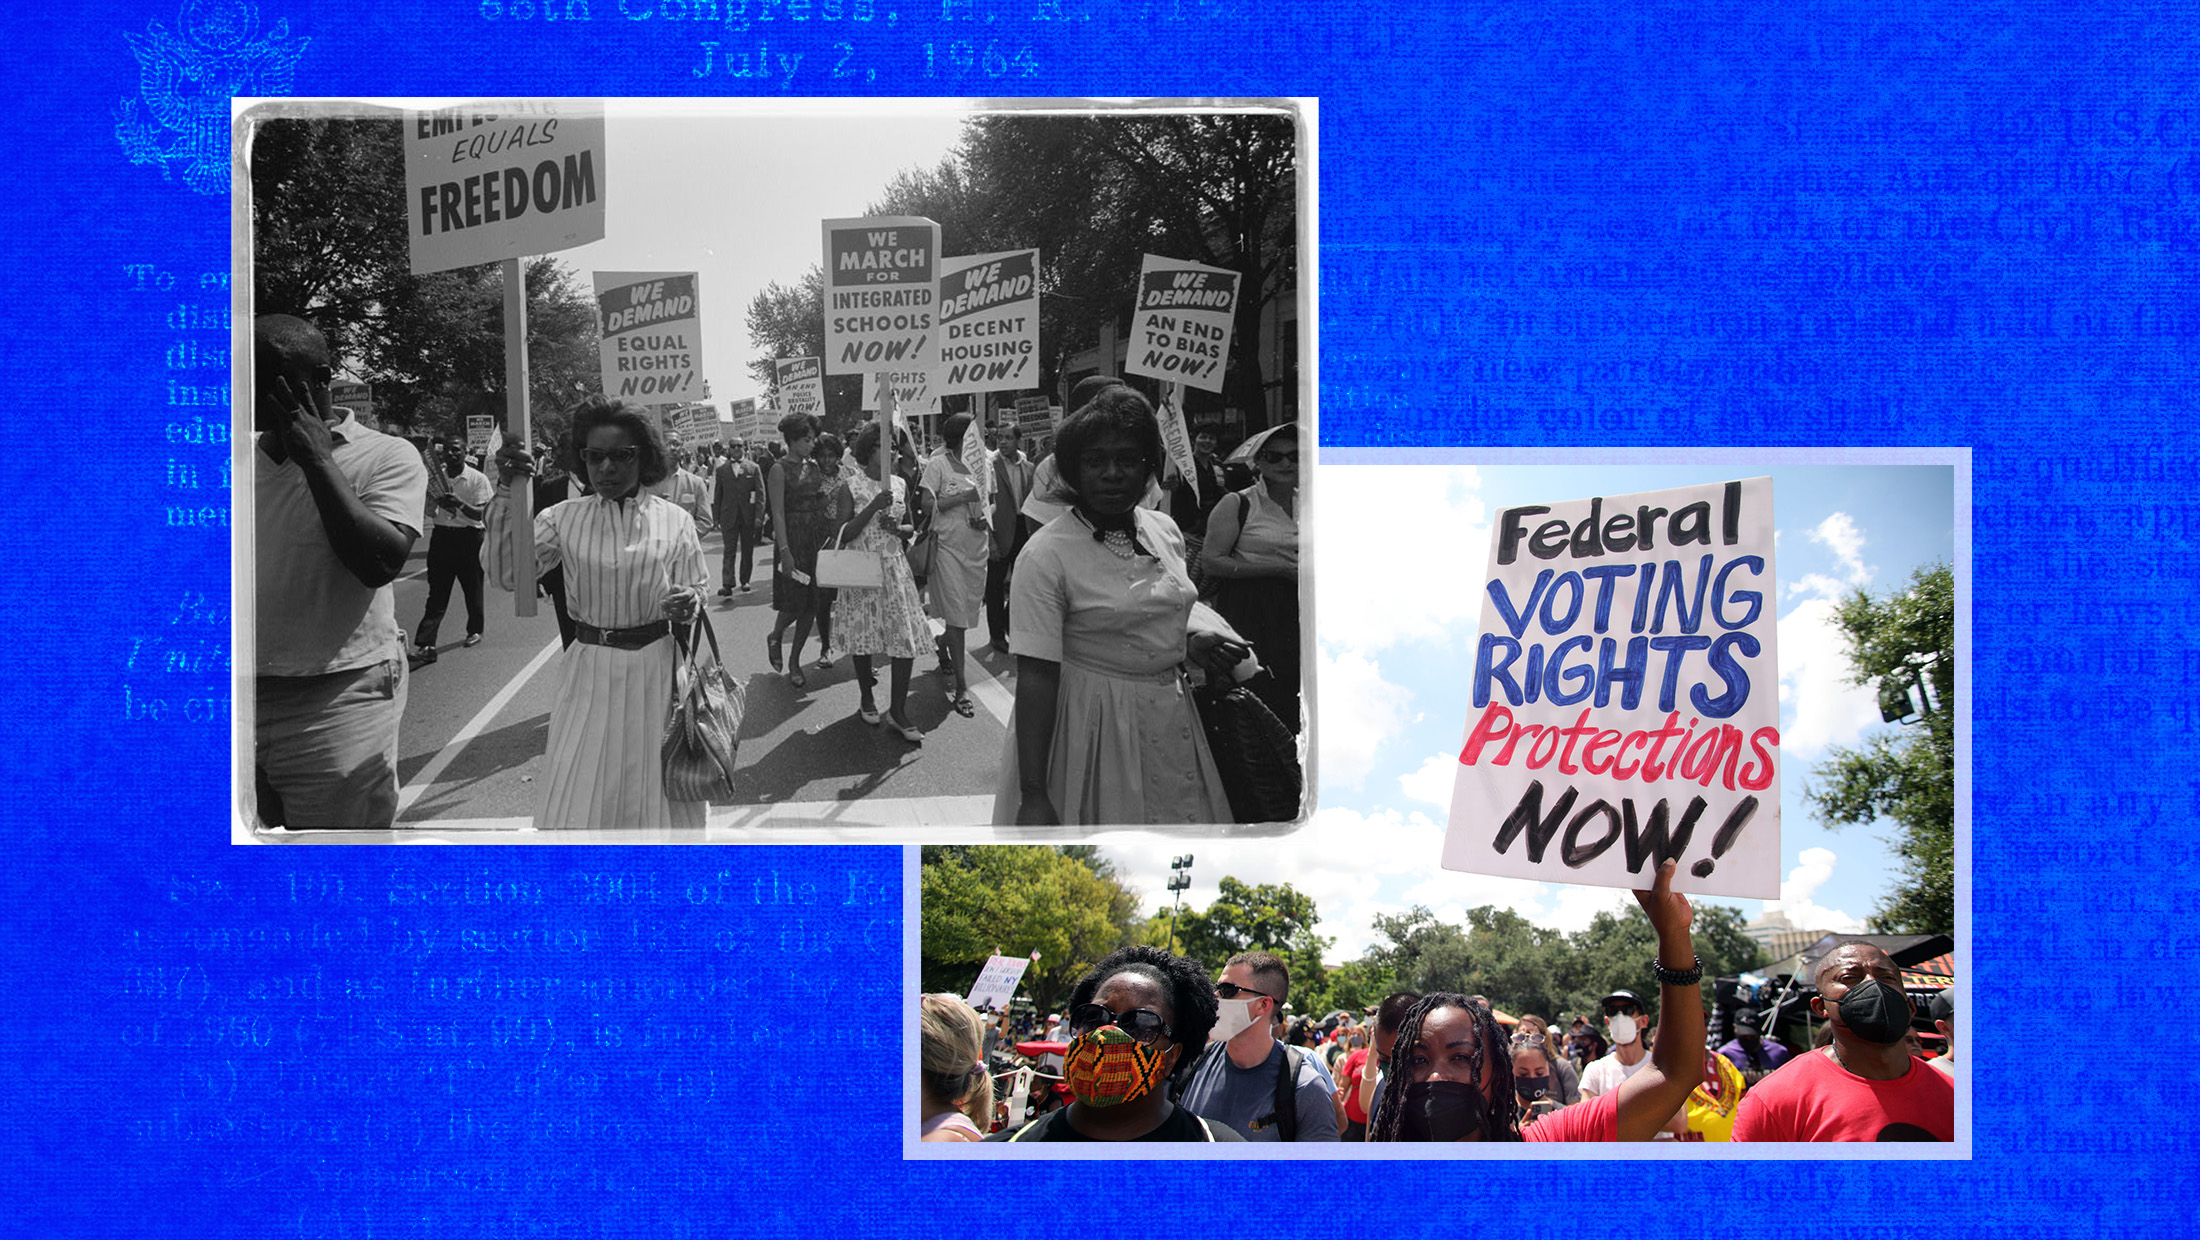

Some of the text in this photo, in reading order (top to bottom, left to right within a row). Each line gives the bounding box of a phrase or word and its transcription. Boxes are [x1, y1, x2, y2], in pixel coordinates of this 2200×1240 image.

[692, 38, 1040, 91] July 2, 1964
[452, 118, 559, 164] EQUALS
[421, 149, 597, 237] FREEDOM
[867, 231, 898, 247] WE
[840, 249, 925, 271] MARCH
[866, 272, 900, 282] FOR
[965, 262, 1002, 290] WE
[1172, 272, 1209, 289] WE
[630, 281, 665, 306] WE
[833, 289, 933, 310] INTEGRATED
[940, 275, 1031, 320] DEMAND
[1146, 289, 1231, 308] DEMAND
[608, 295, 693, 332] DEMAND
[833, 314, 931, 334] SCHOOLS
[949, 318, 1026, 340] DECENT
[1146, 314, 1225, 342] AN END
[618, 335, 688, 352] EQUAL
[841, 334, 927, 364] NOW!
[941, 340, 1034, 362] HOUSING
[1145, 331, 1220, 359] TO BIAS
[618, 354, 691, 372] RIGHTS
[782, 366, 818, 385] DEMAND
[791, 360, 807, 372] WE
[948, 355, 1029, 385] NOW!
[1142, 350, 1218, 380] NOW!
[620, 370, 694, 397] NOW!
[874, 372, 926, 384] RGHTS
[788, 401, 821, 413] NOW!
[1497, 481, 1742, 566] Federal
[1486, 553, 1765, 640] VOTING
[1472, 630, 1762, 719] RIGHTS
[1458, 700, 1780, 792] Protections
[1492, 778, 1760, 879] NOW!
[752, 868, 818, 905] the
[1003, 976, 1019, 985] NY
